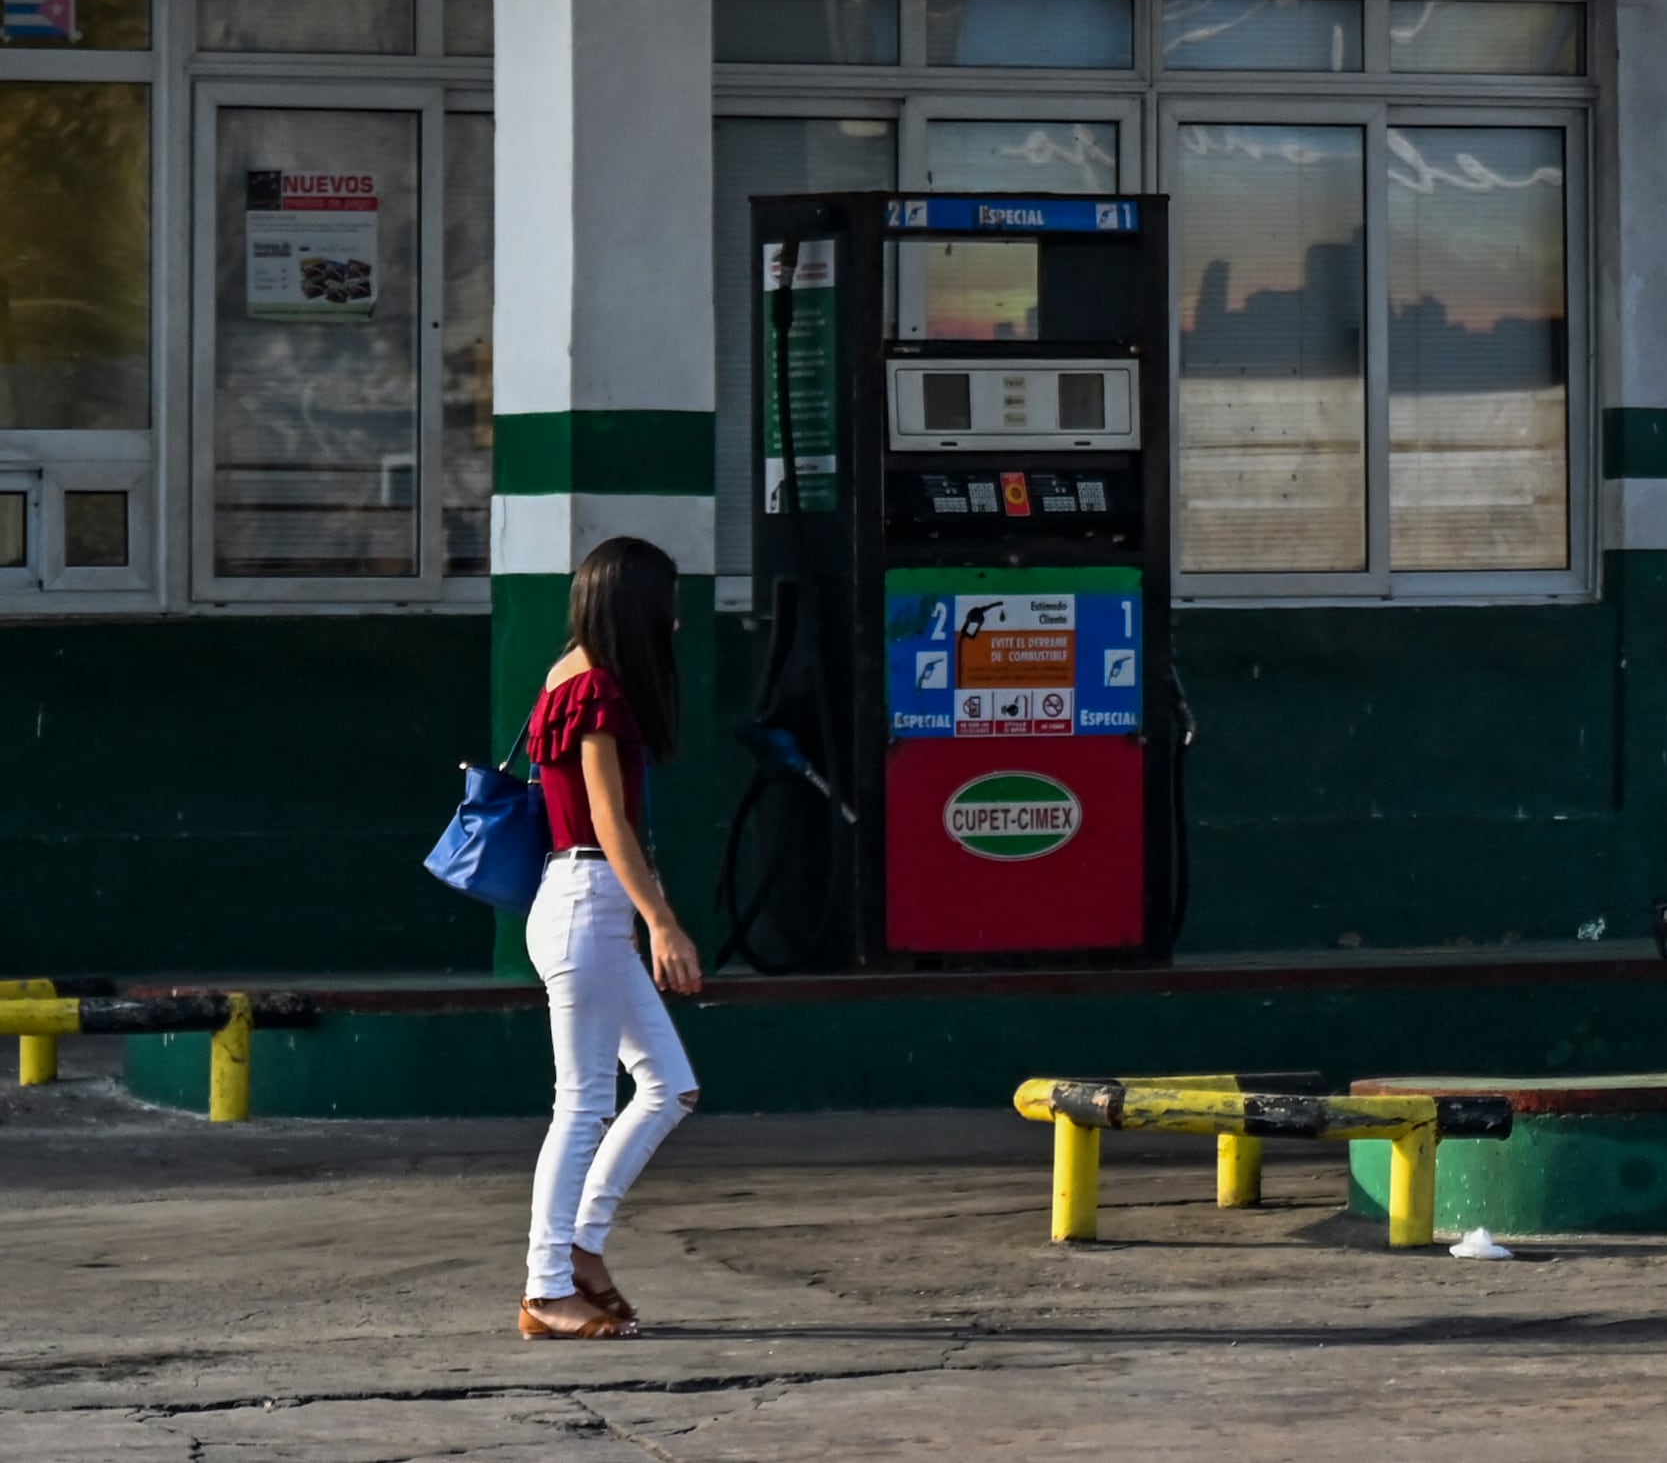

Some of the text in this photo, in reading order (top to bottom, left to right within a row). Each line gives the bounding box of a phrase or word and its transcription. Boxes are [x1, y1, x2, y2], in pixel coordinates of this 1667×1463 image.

[283, 175, 374, 194] NUEVOS
[887, 201, 1133, 230] 2 ESPECIAL 1
[1030, 600, 1068, 613] Estimado
[931, 601, 948, 641] 2
[1038, 613, 1068, 625] Cliente
[1121, 600, 1133, 638] 1
[991, 637, 1068, 649] EVITE EL DERRAME
[991, 649, 1068, 662] DE COMBUSTIBLE
[893, 712, 951, 729] ESPECIAL
[952, 804, 1074, 832] CUPET-CIMEX
